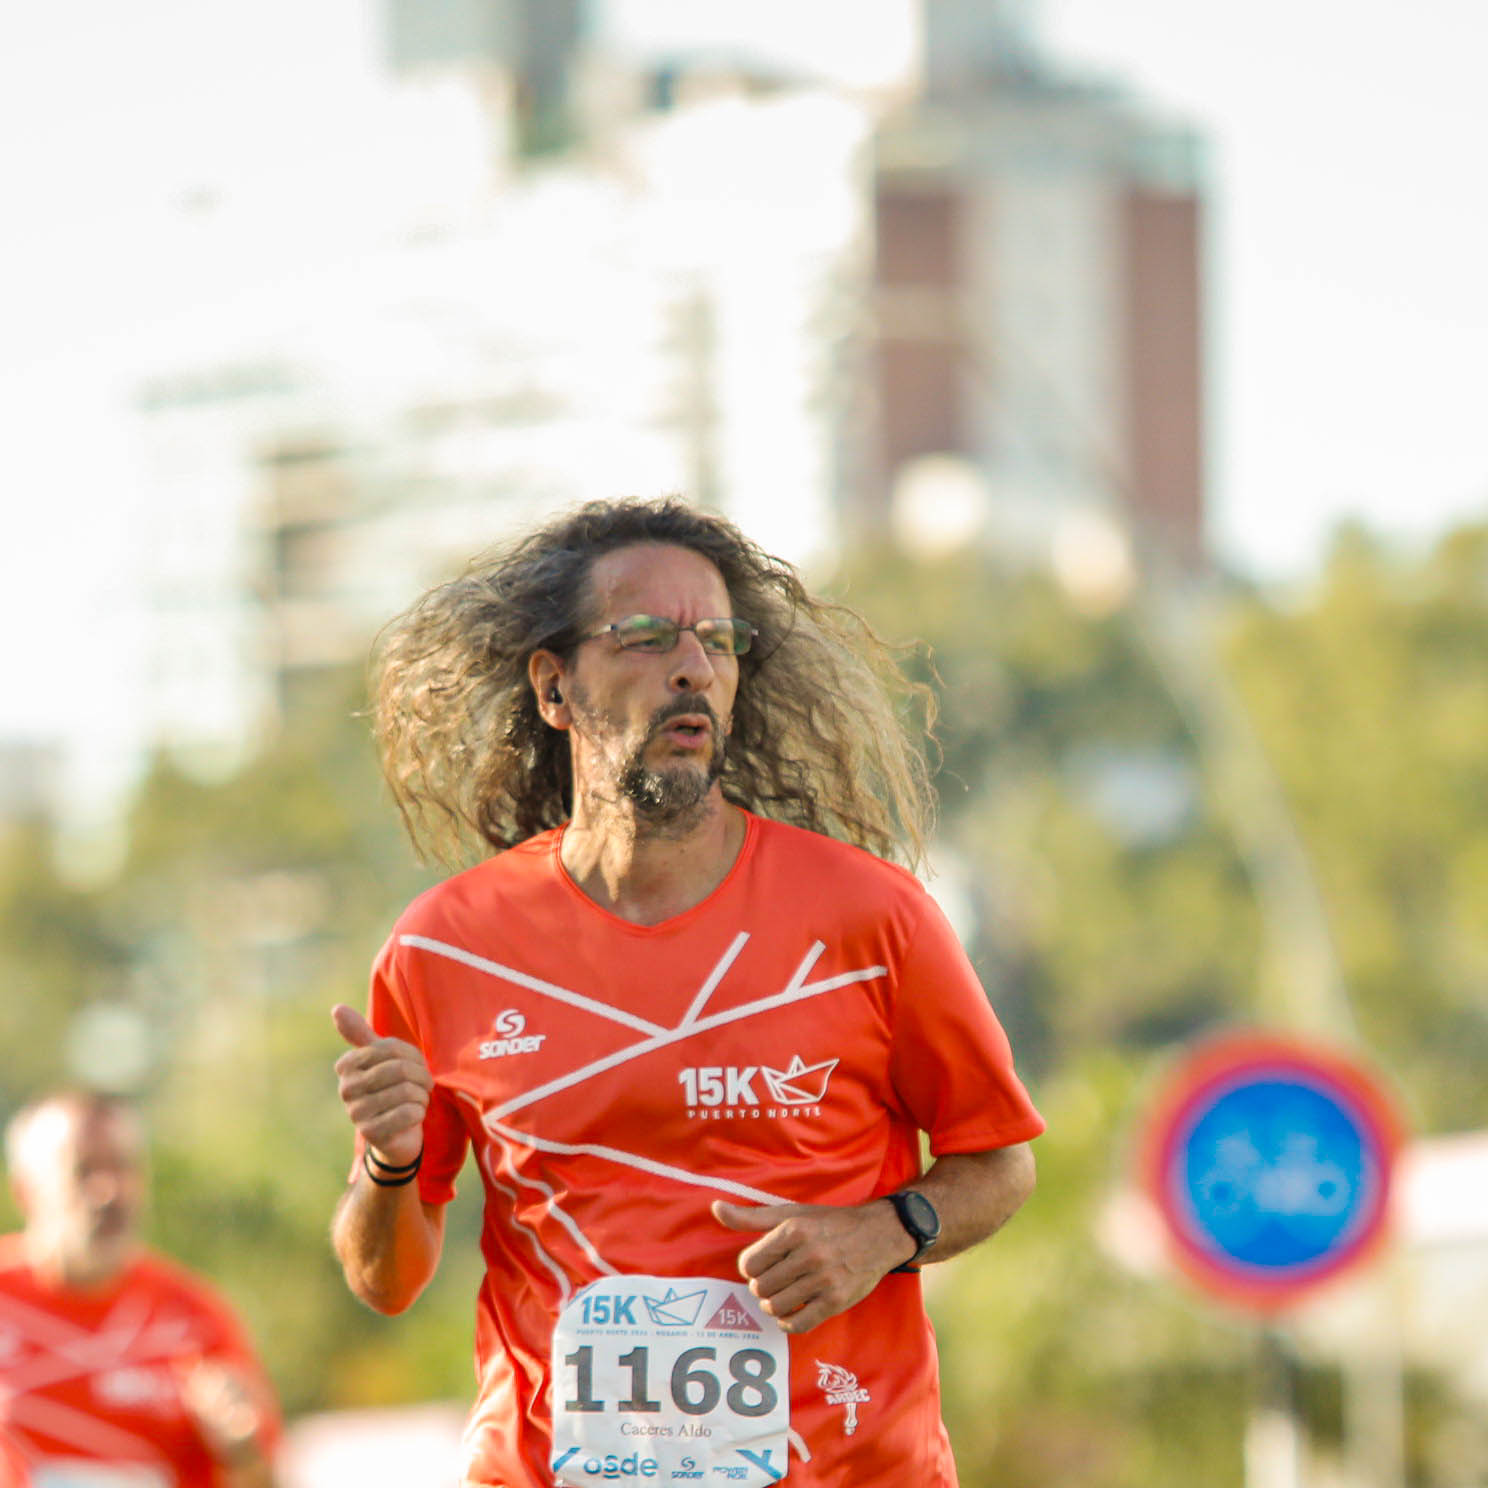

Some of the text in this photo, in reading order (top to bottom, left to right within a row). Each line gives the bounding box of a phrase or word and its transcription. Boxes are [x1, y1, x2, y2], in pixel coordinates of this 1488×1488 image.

[678, 1066, 760, 1107] 15K
[686, 1106, 821, 1119] PUERTO NORTE
[581, 1295, 637, 1325] 15K
[719, 1309, 749, 1326] 15K
[564, 1345, 778, 1416] 1168
[620, 1422, 712, 1438] Caceres Aldo
[583, 1451, 658, 1478] osde
